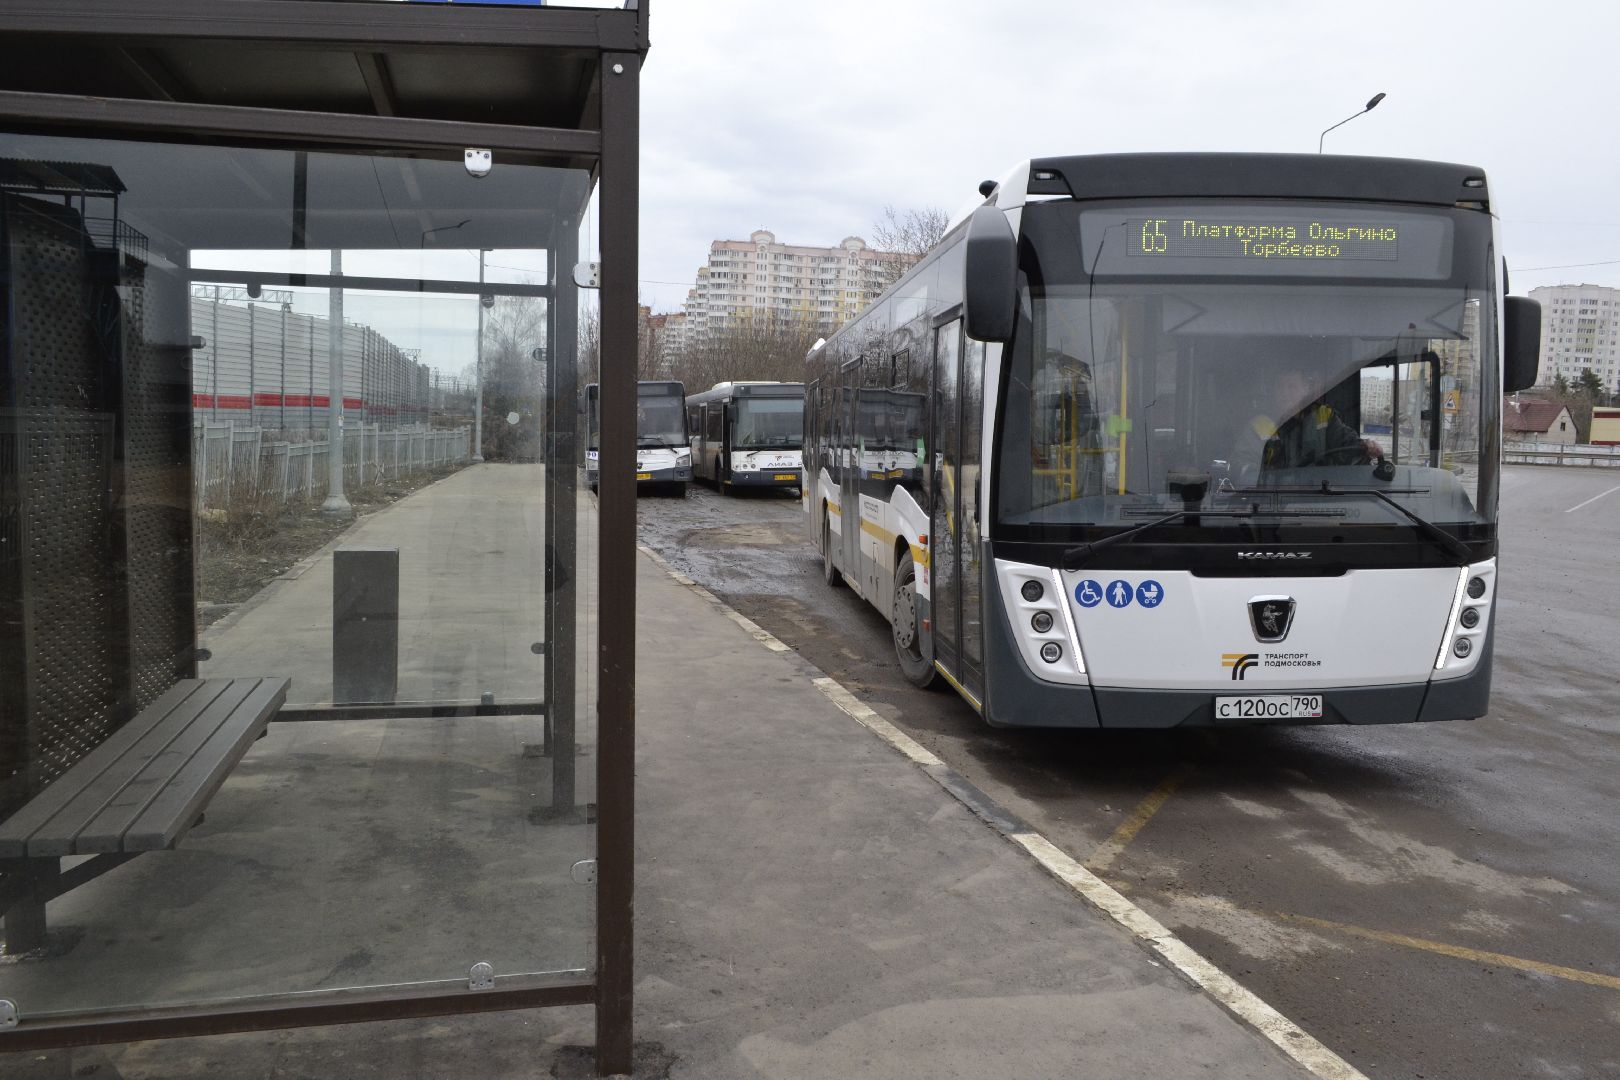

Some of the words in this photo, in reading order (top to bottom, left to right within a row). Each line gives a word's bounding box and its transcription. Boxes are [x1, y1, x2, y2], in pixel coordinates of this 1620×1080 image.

[1142, 219, 1168, 252] 65
[1183, 220, 1297, 241] Платформа
[1309, 222, 1397, 241] Ольгино
[1240, 239, 1341, 258] Торбеево
[1237, 551, 1313, 560] KAMAZ
[1264, 660, 1322, 668] ПОДМОСКОВЬЯ
[1292, 697, 1319, 711] 790
